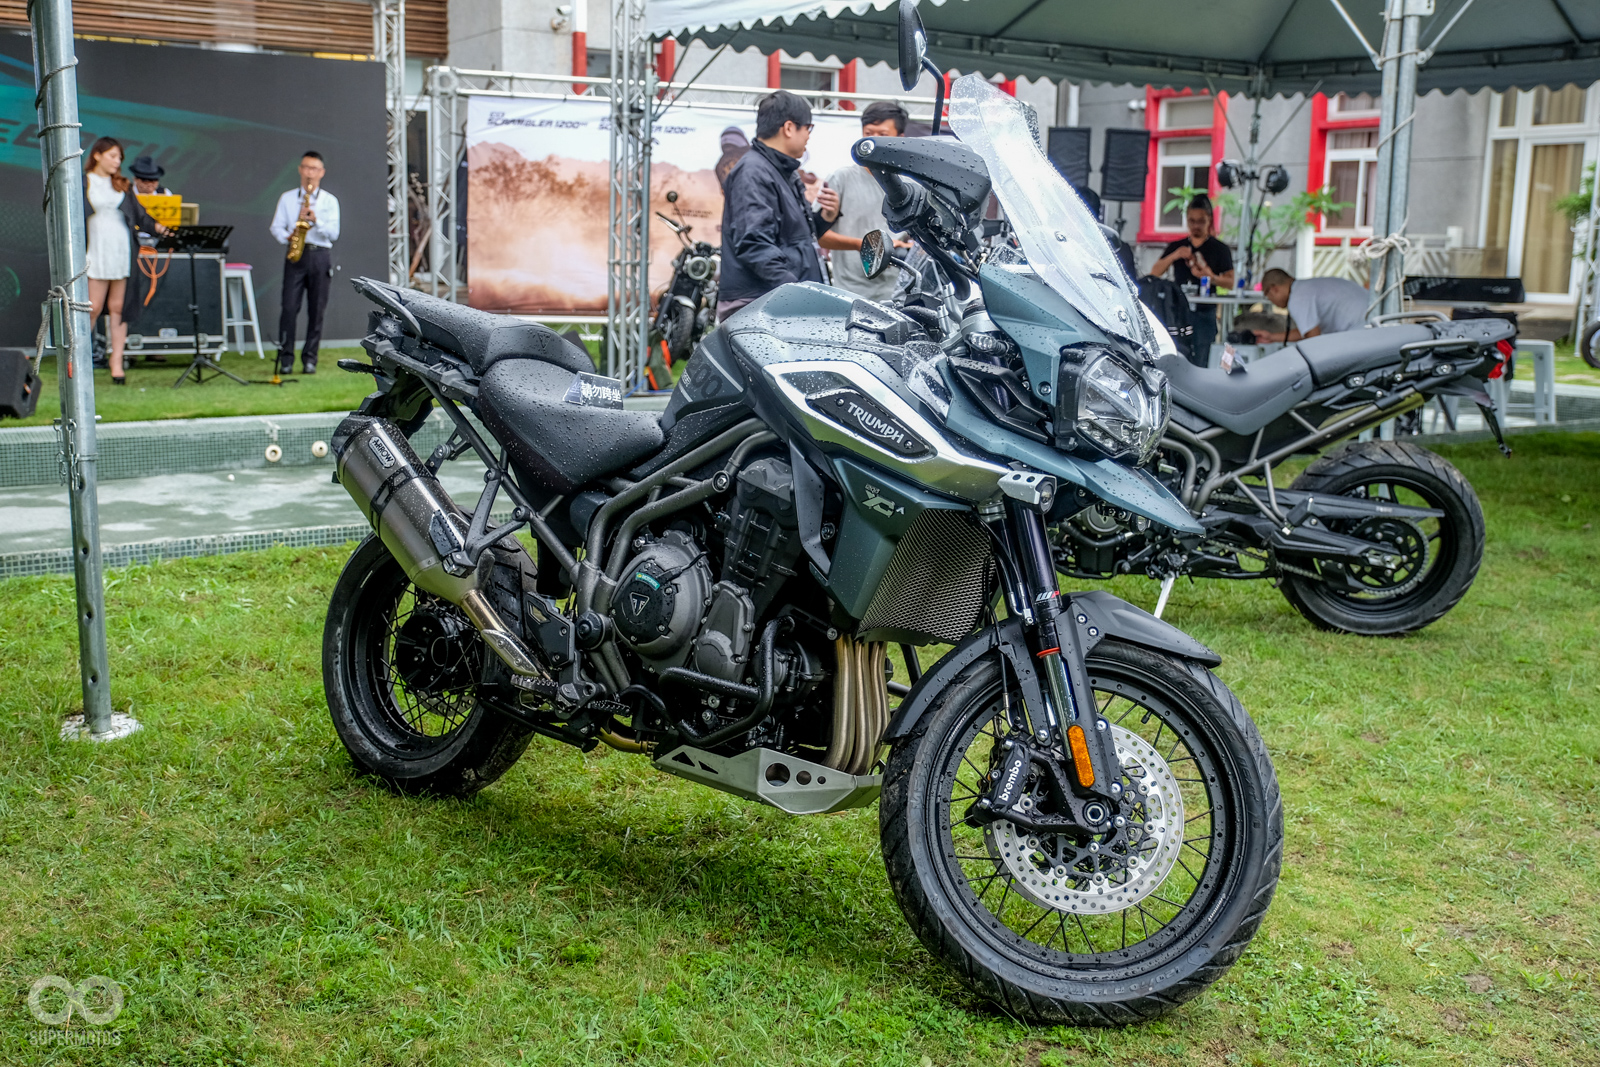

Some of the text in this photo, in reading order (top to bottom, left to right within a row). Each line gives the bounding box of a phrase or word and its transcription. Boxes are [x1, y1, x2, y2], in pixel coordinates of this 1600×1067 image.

[847, 402, 904, 444] TRIUMPH
[372, 438, 394, 462] ARROW
[998, 759, 1022, 802] brembo
